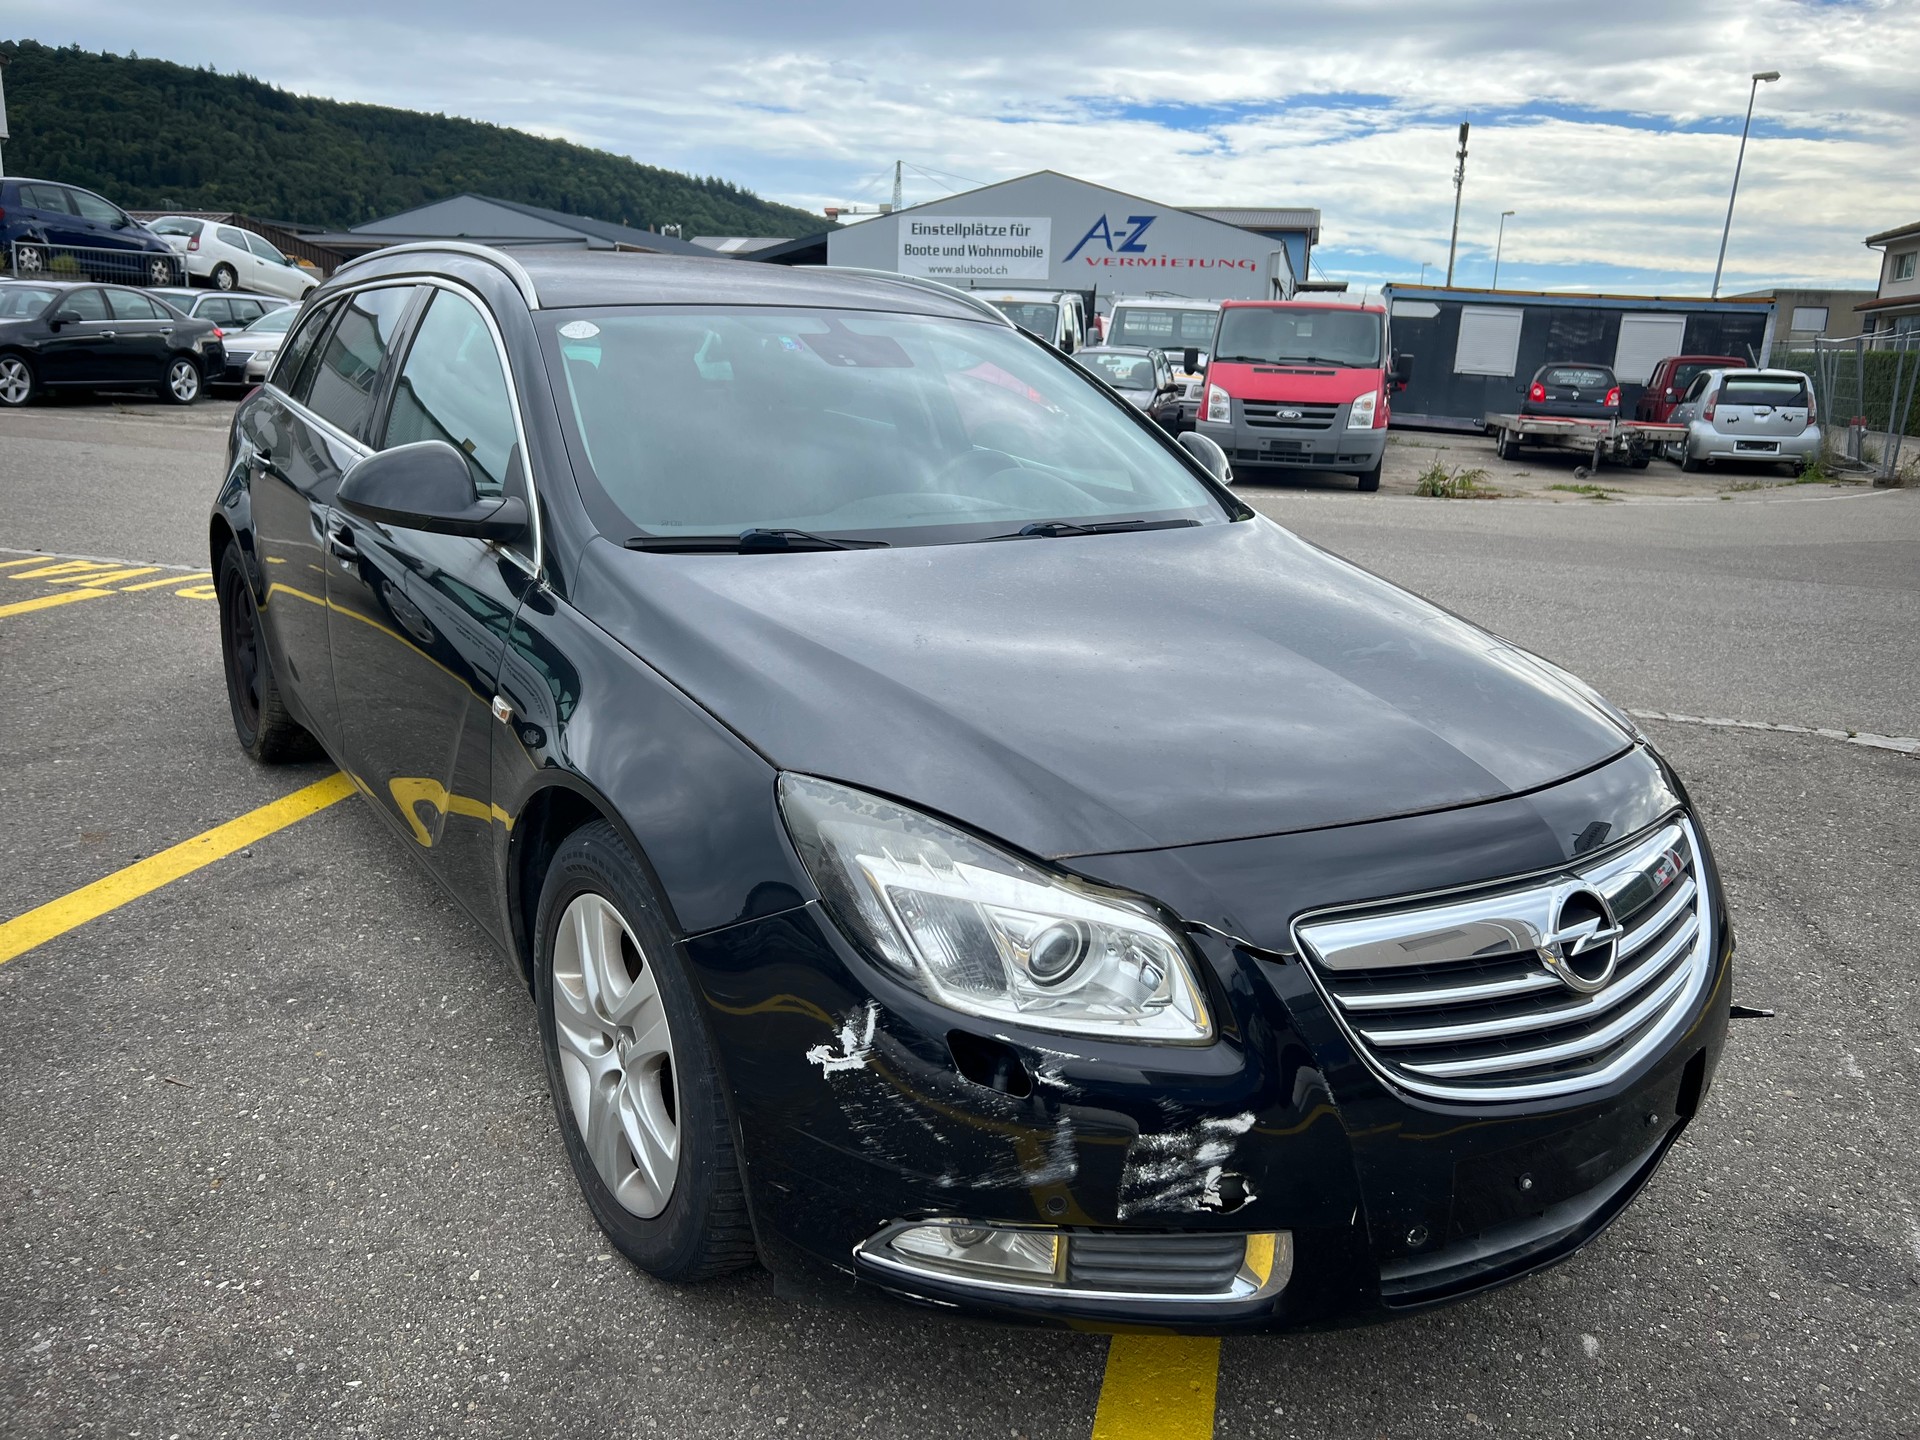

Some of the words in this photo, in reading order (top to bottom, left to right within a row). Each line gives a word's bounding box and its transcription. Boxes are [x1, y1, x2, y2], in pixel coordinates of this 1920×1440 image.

[911, 222, 1006, 238] Einstellplätze
[1009, 223, 1031, 237] für
[1062, 213, 1158, 263] A-Z
[904, 244, 940, 256] Boote
[942, 244, 965, 257] und
[967, 243, 1043, 258] Wohnmobile
[928, 264, 1009, 275] www.aluboot.ch
